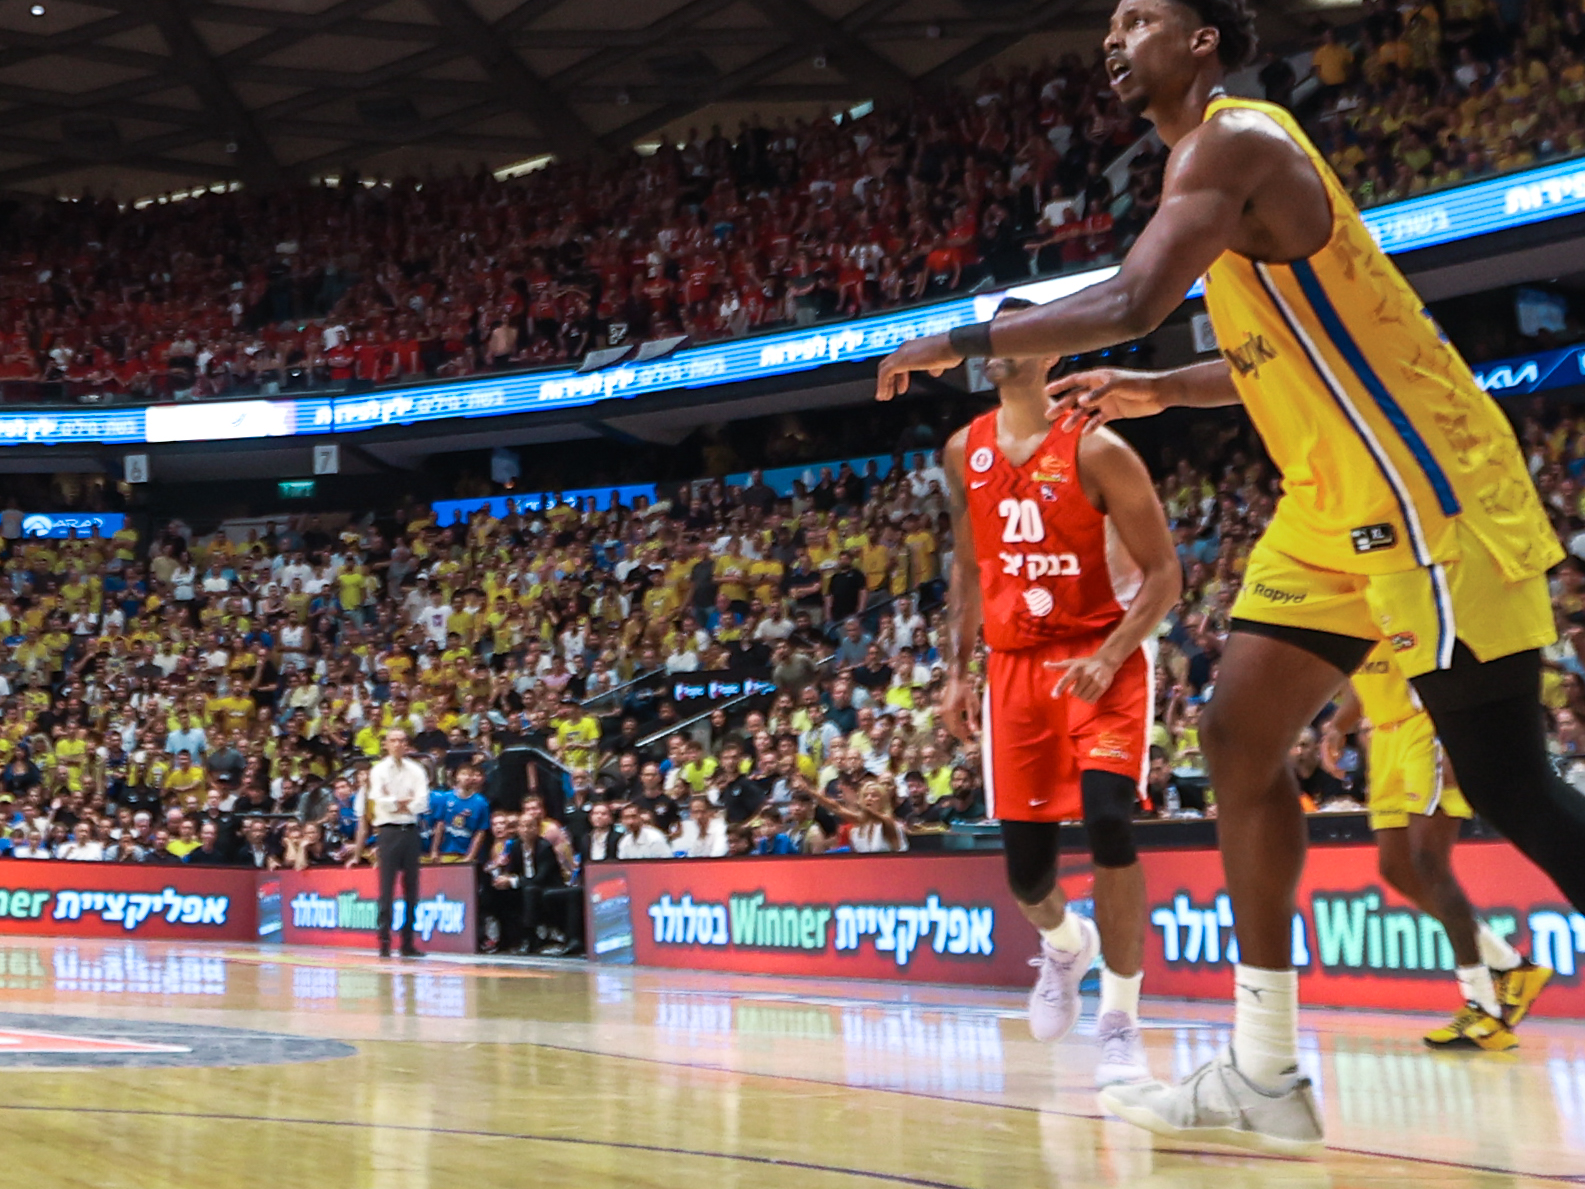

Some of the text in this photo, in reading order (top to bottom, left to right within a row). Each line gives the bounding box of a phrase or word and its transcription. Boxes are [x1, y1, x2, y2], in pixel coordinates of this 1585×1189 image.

[998, 498, 1045, 544] 20
[1252, 583, 1308, 605] Rapyd
[52, 886, 229, 929] אפליקציית
[648, 889, 995, 967] בסלולר Winner אפליקציית
[1313, 892, 1516, 970] Winnr
